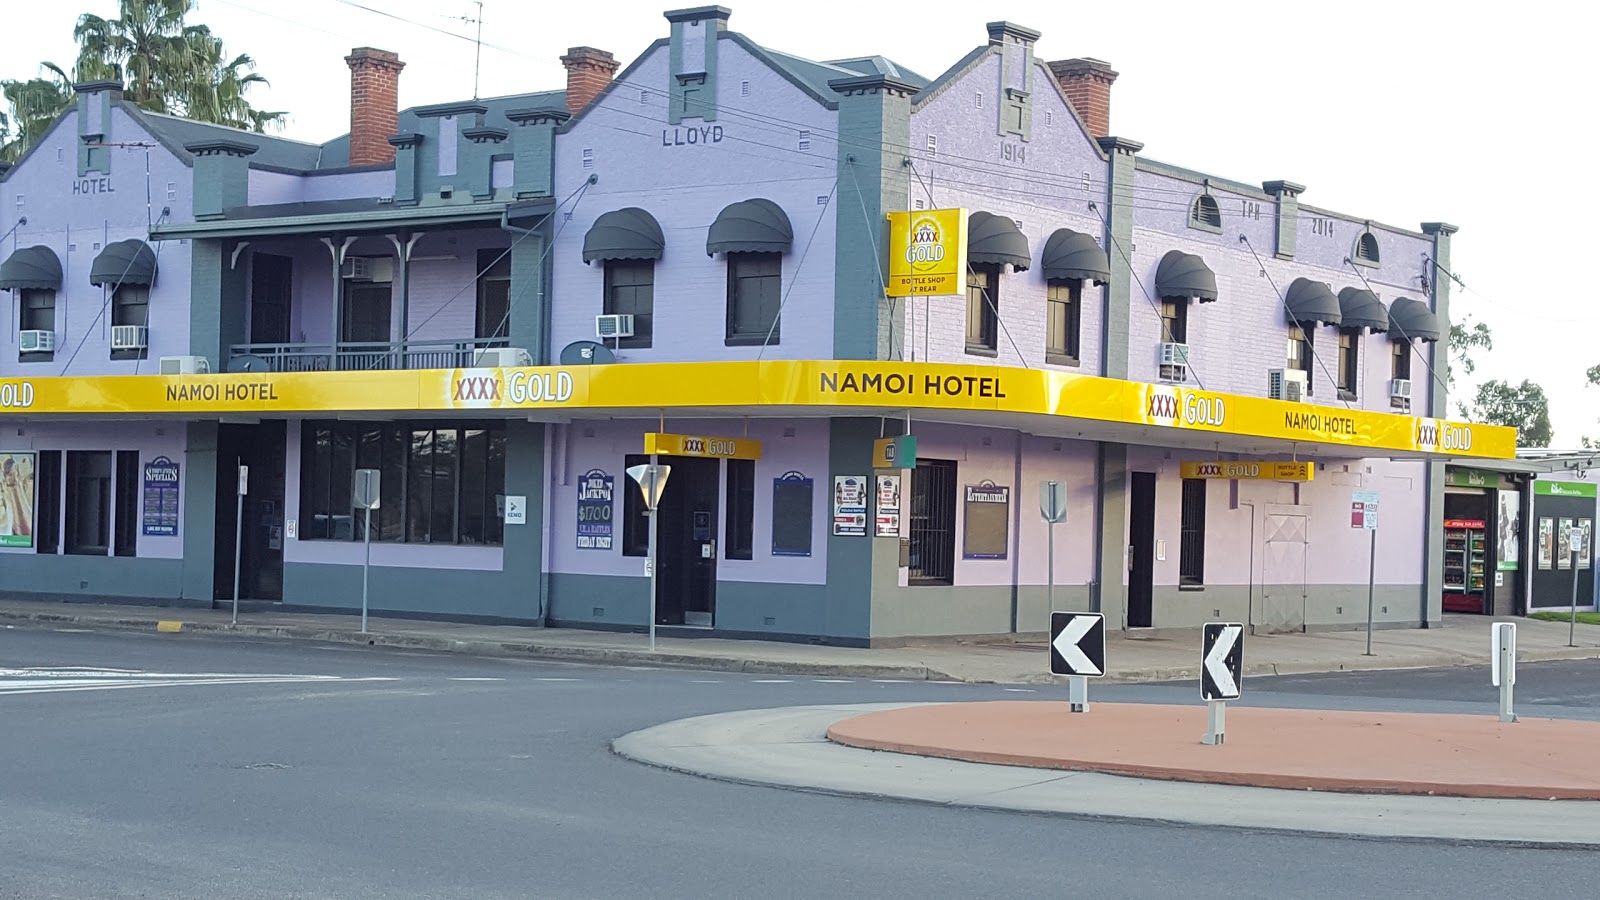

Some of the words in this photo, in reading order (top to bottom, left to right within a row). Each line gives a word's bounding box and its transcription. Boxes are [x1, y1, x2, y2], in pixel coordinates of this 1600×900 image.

[662, 126, 724, 147] LLOYD
[1000, 141, 1026, 164] 1914
[72, 178, 115, 195] HOTEL
[912, 231, 939, 244] XXXX
[1312, 218, 1333, 238] 2014
[905, 244, 946, 264] GOLD
[927, 276, 946, 284] SHOP
[0, 381, 35, 408] OLD
[166, 384, 220, 402] NAMOI
[225, 383, 279, 400] HOTEL
[453, 376, 501, 401] XXXX
[509, 371, 574, 404] GOLD
[820, 372, 914, 394] NAMOI
[924, 375, 1006, 398] HOTEL
[1147, 394, 1180, 420] XXXX
[1185, 393, 1226, 426] GOLD
[1284, 411, 1321, 430] NAMOI
[1323, 415, 1358, 435] HOTEL
[1416, 425, 1441, 447] XXXX
[1442, 423, 1473, 451] GOLD
[683, 439, 706, 453] XXXX
[709, 439, 736, 456] GOLD
[886, 447, 895, 458] TAB
[1196, 464, 1222, 476] XXXX
[1226, 463, 1260, 477] GOLD
[579, 481, 613, 501] JACKPOT
[578, 505, 611, 521] $1700
